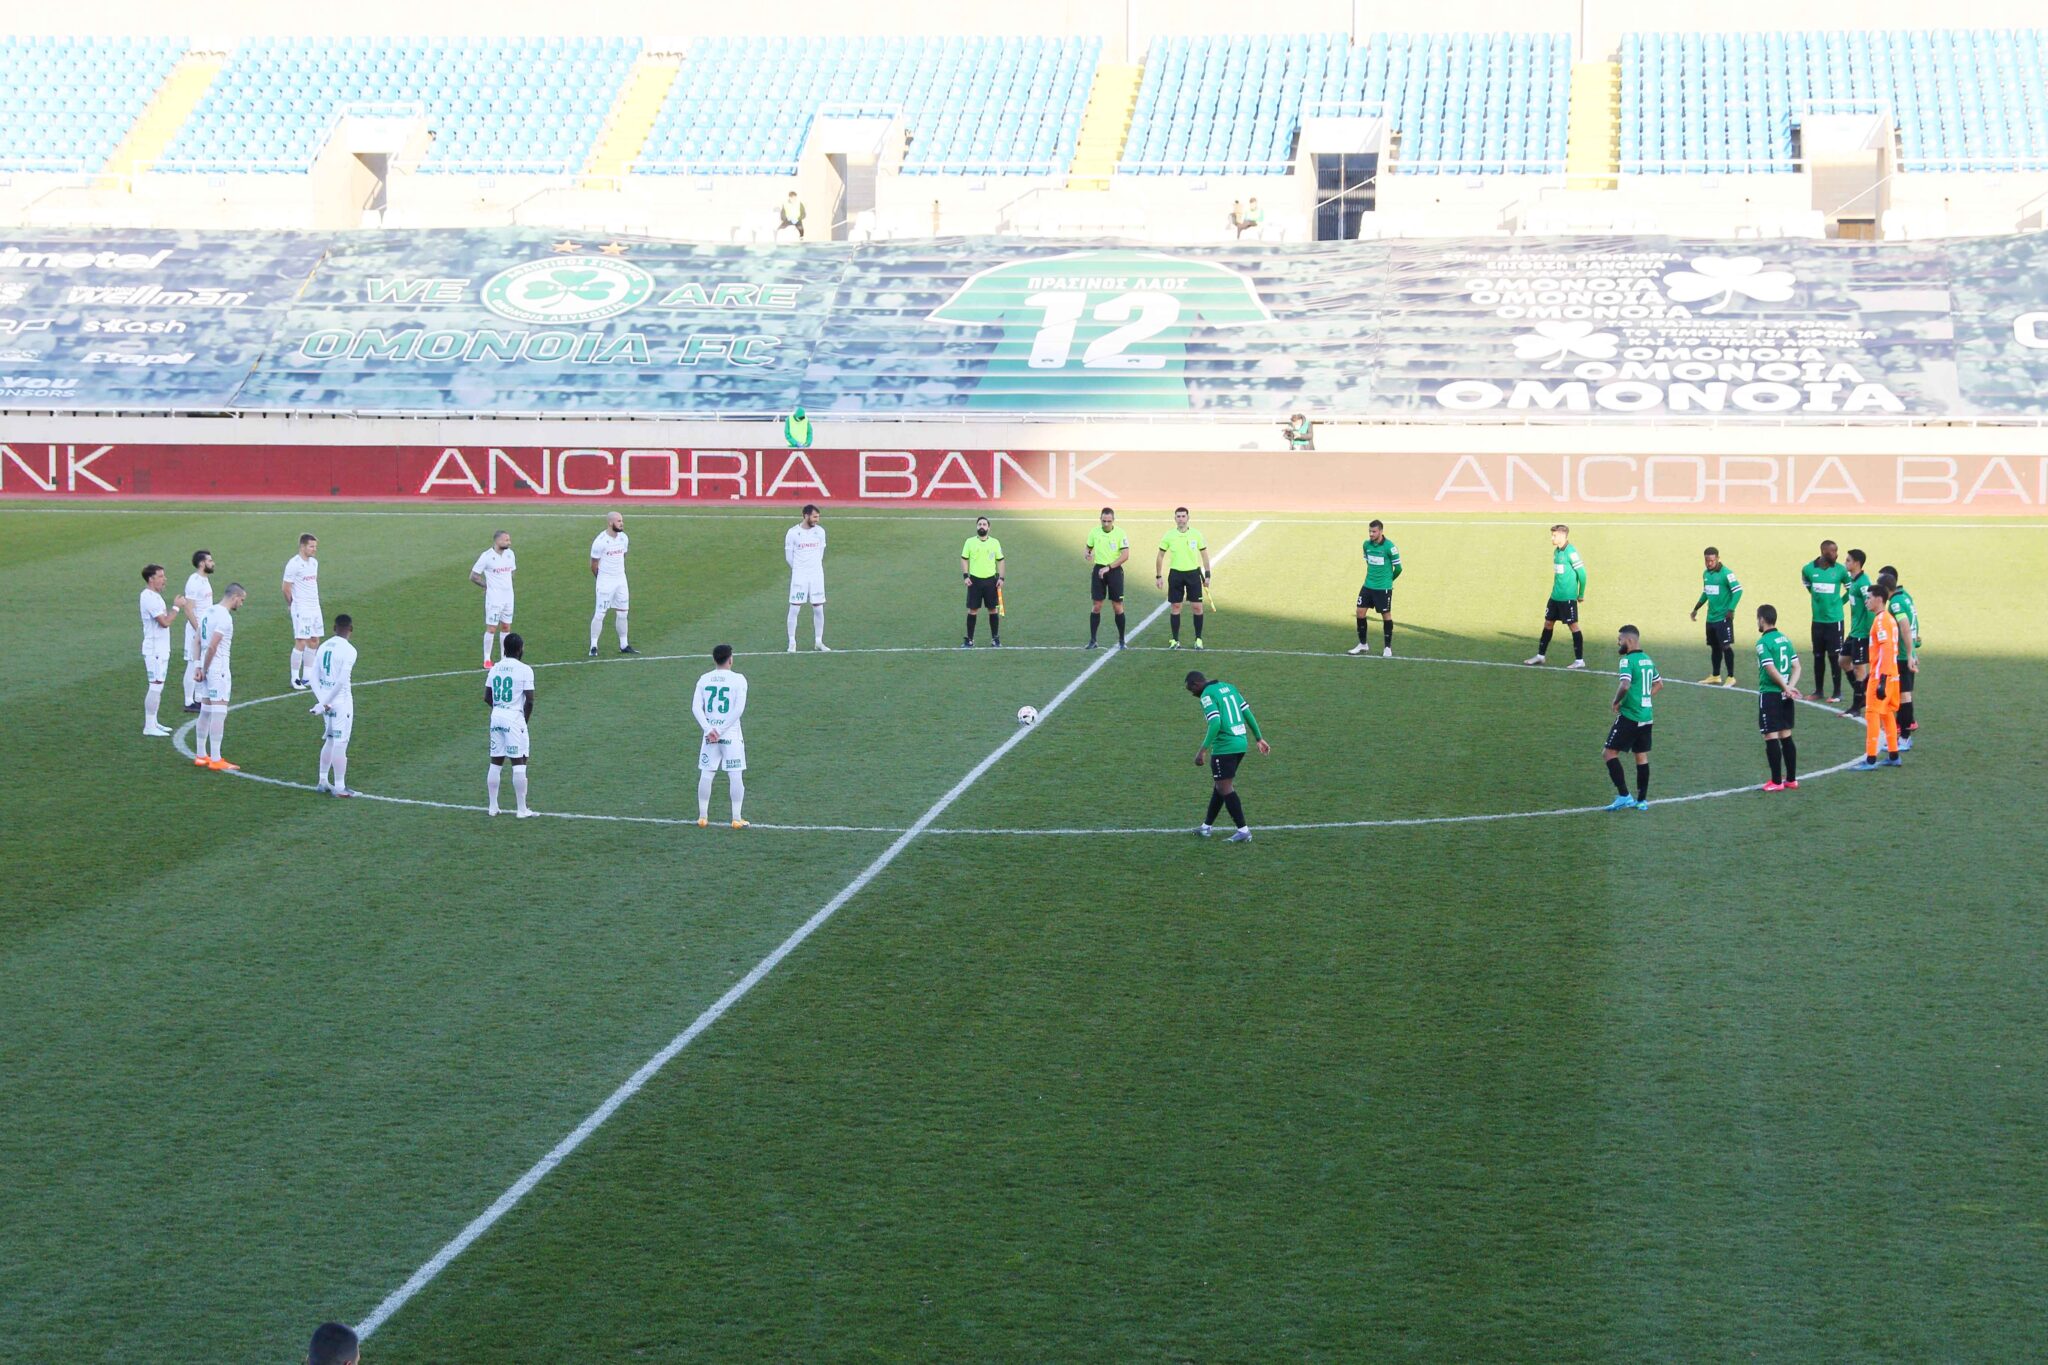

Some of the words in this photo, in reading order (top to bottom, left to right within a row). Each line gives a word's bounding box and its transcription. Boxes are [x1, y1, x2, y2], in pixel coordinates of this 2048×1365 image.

[367, 278, 470, 303] WE
[658, 282, 804, 309] ARE
[1028, 277, 1128, 290] ΠΡΑΣΙΝΟΣ
[1133, 277, 1189, 290] ΛΑΟΣ
[1024, 290, 1181, 369] 12
[299, 328, 651, 365] OMONOIA
[678, 333, 782, 367] FC
[420, 447, 831, 498] ANCORIA
[858, 451, 1118, 499] BANK
[1434, 455, 1866, 504] ANCORIA
[1895, 456, 2048, 504] BA
[323, 650, 333, 676] 4
[1779, 646, 1789, 673] 5
[492, 675, 514, 703] 88
[1641, 668, 1653, 696] 10
[704, 685, 730, 714] 75
[1222, 694, 1242, 724] 11
